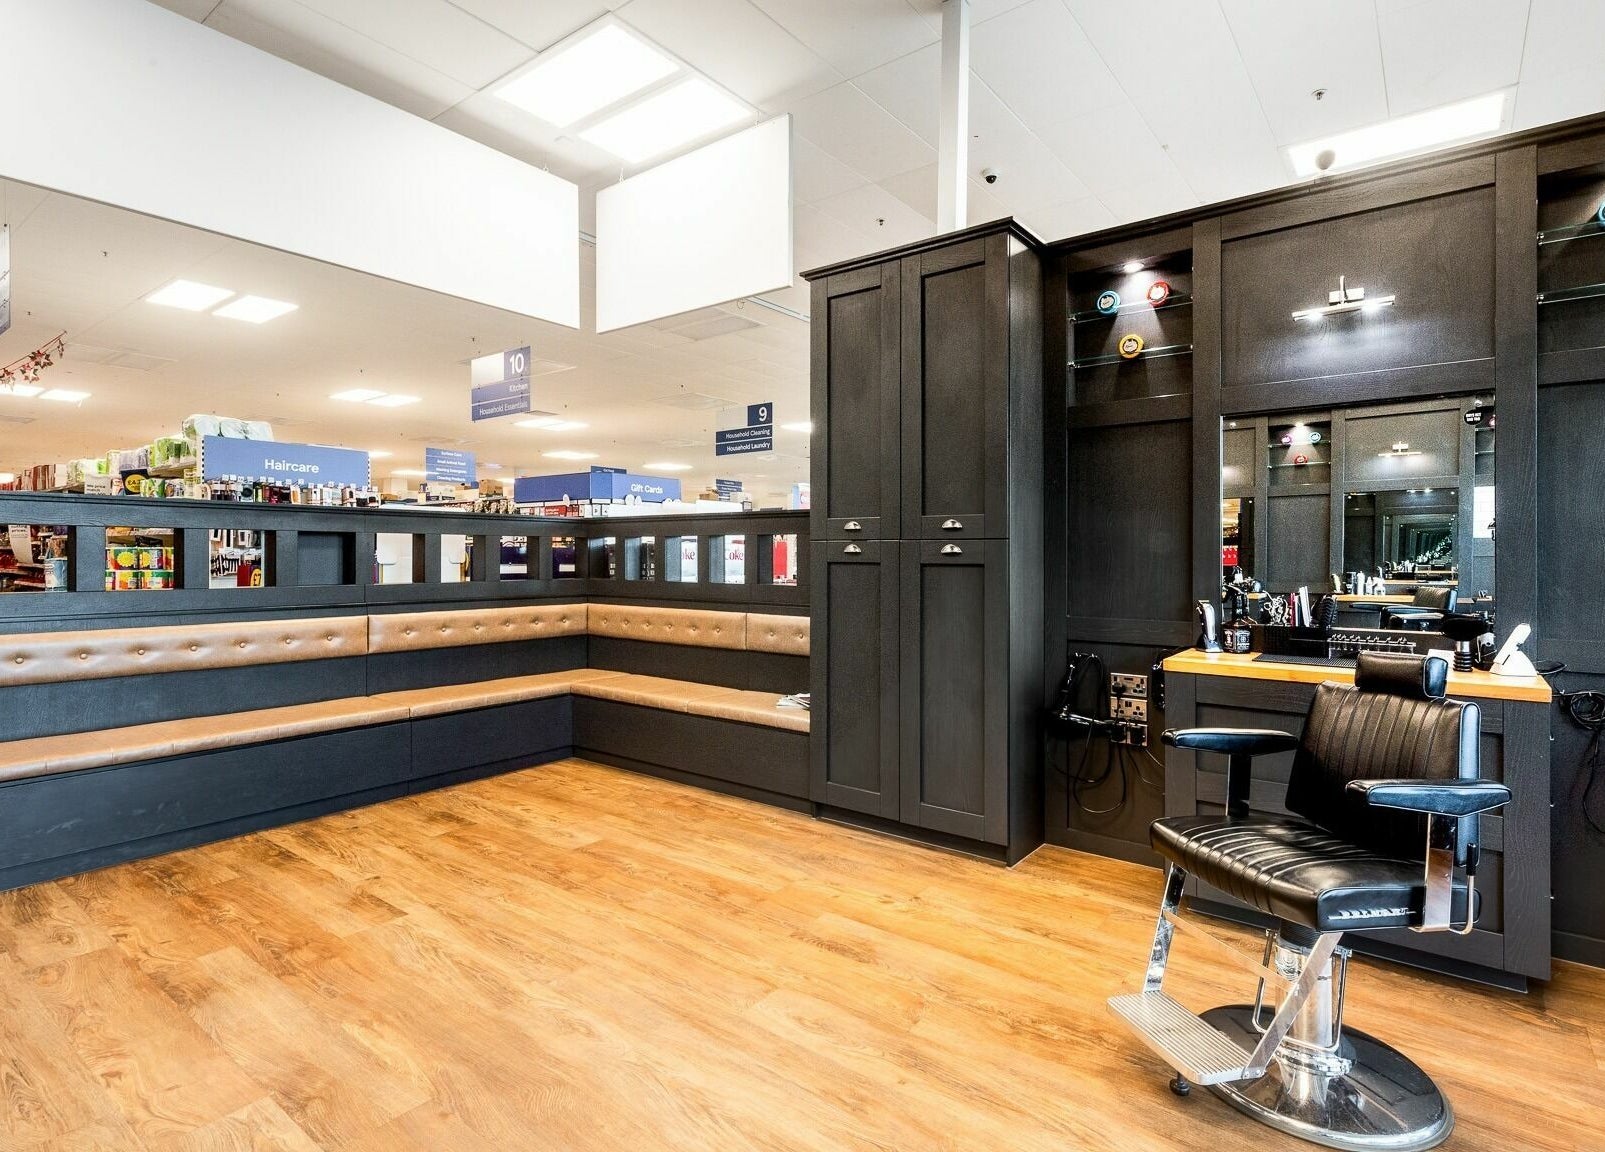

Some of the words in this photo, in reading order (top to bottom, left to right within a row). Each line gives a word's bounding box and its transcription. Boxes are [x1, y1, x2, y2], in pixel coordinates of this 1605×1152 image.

[509, 353, 524, 374] 10
[480, 404, 503, 416] Household
[758, 406, 767, 421] 9
[726, 431, 749, 439] Household
[727, 443, 750, 452] Household
[265, 458, 319, 473] Haircare
[631, 483, 643, 493] Gift
[644, 484, 663, 494] Cards
